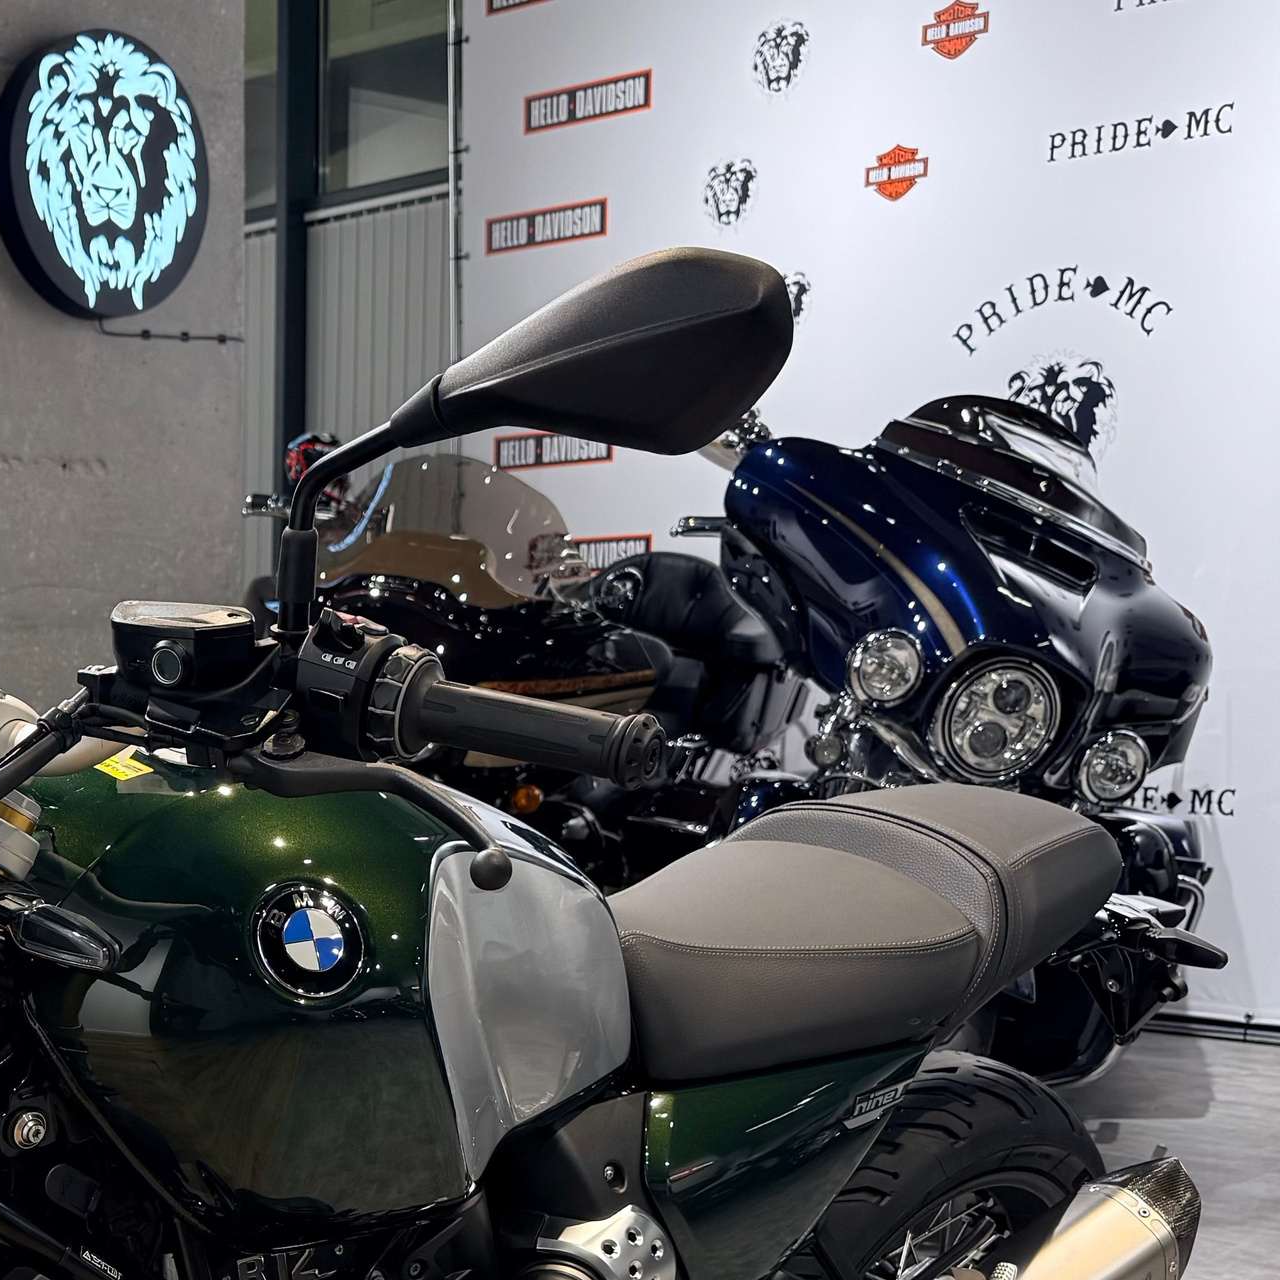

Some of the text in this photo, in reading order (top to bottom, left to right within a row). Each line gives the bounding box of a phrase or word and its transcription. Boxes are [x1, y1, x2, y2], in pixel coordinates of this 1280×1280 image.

[530, 76, 646, 129] HELLO DAVIDSON
[1047, 102, 1235, 163] PRIDE MC
[491, 203, 602, 251] HELLO DAVIDSON
[951, 263, 1174, 357] PRIDE MC
[499, 435, 608, 467] HELLO DAVIDSON
[1187, 788, 1237, 817] MC
[266, 892, 347, 928] BMW
